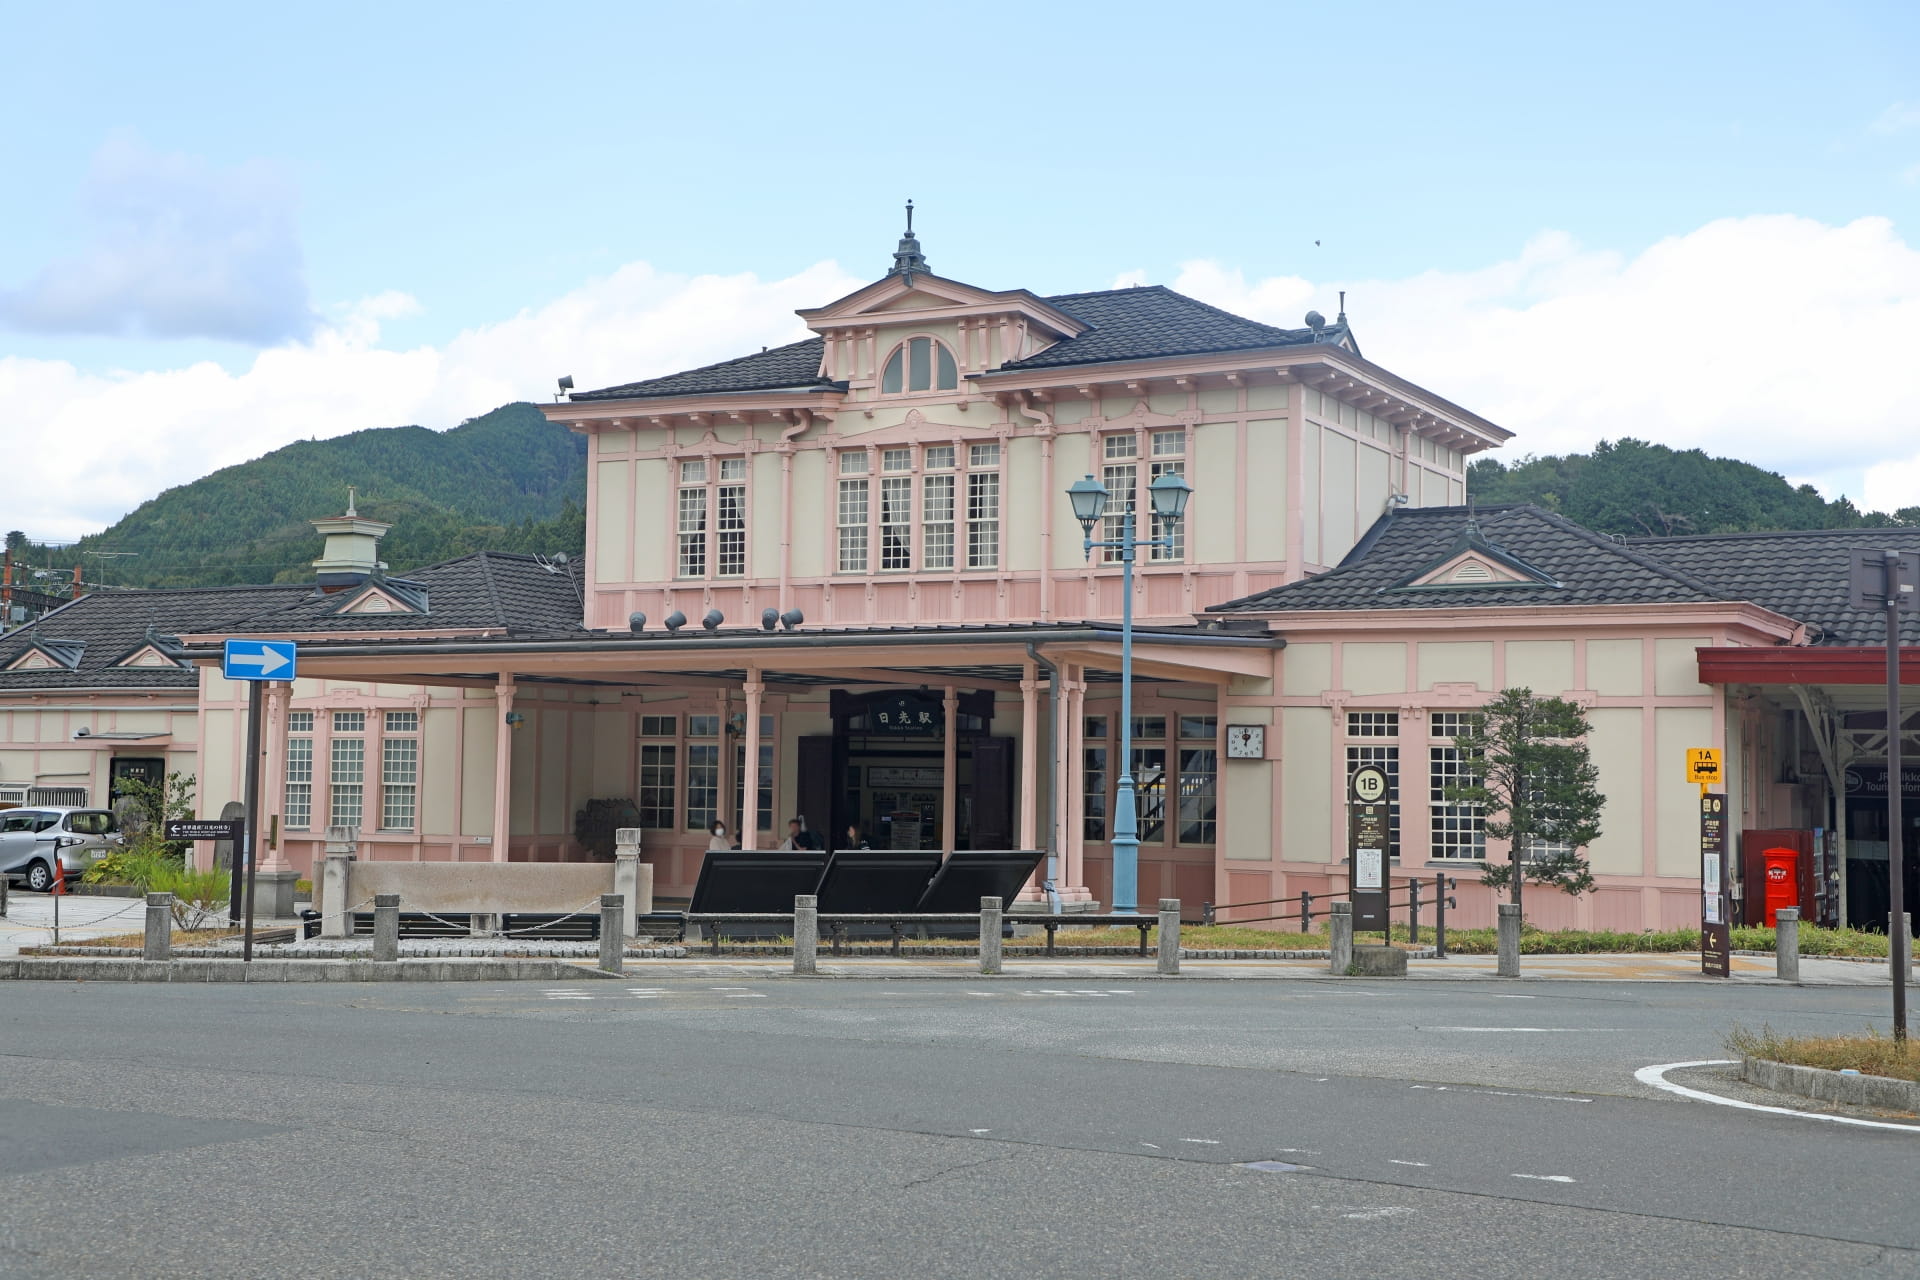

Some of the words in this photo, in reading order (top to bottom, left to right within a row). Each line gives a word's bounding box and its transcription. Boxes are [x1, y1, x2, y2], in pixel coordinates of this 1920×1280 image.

[878, 711, 932, 724] 日光駅
[1698, 750, 1712, 760] 1A
[1361, 778, 1378, 790] 1B
